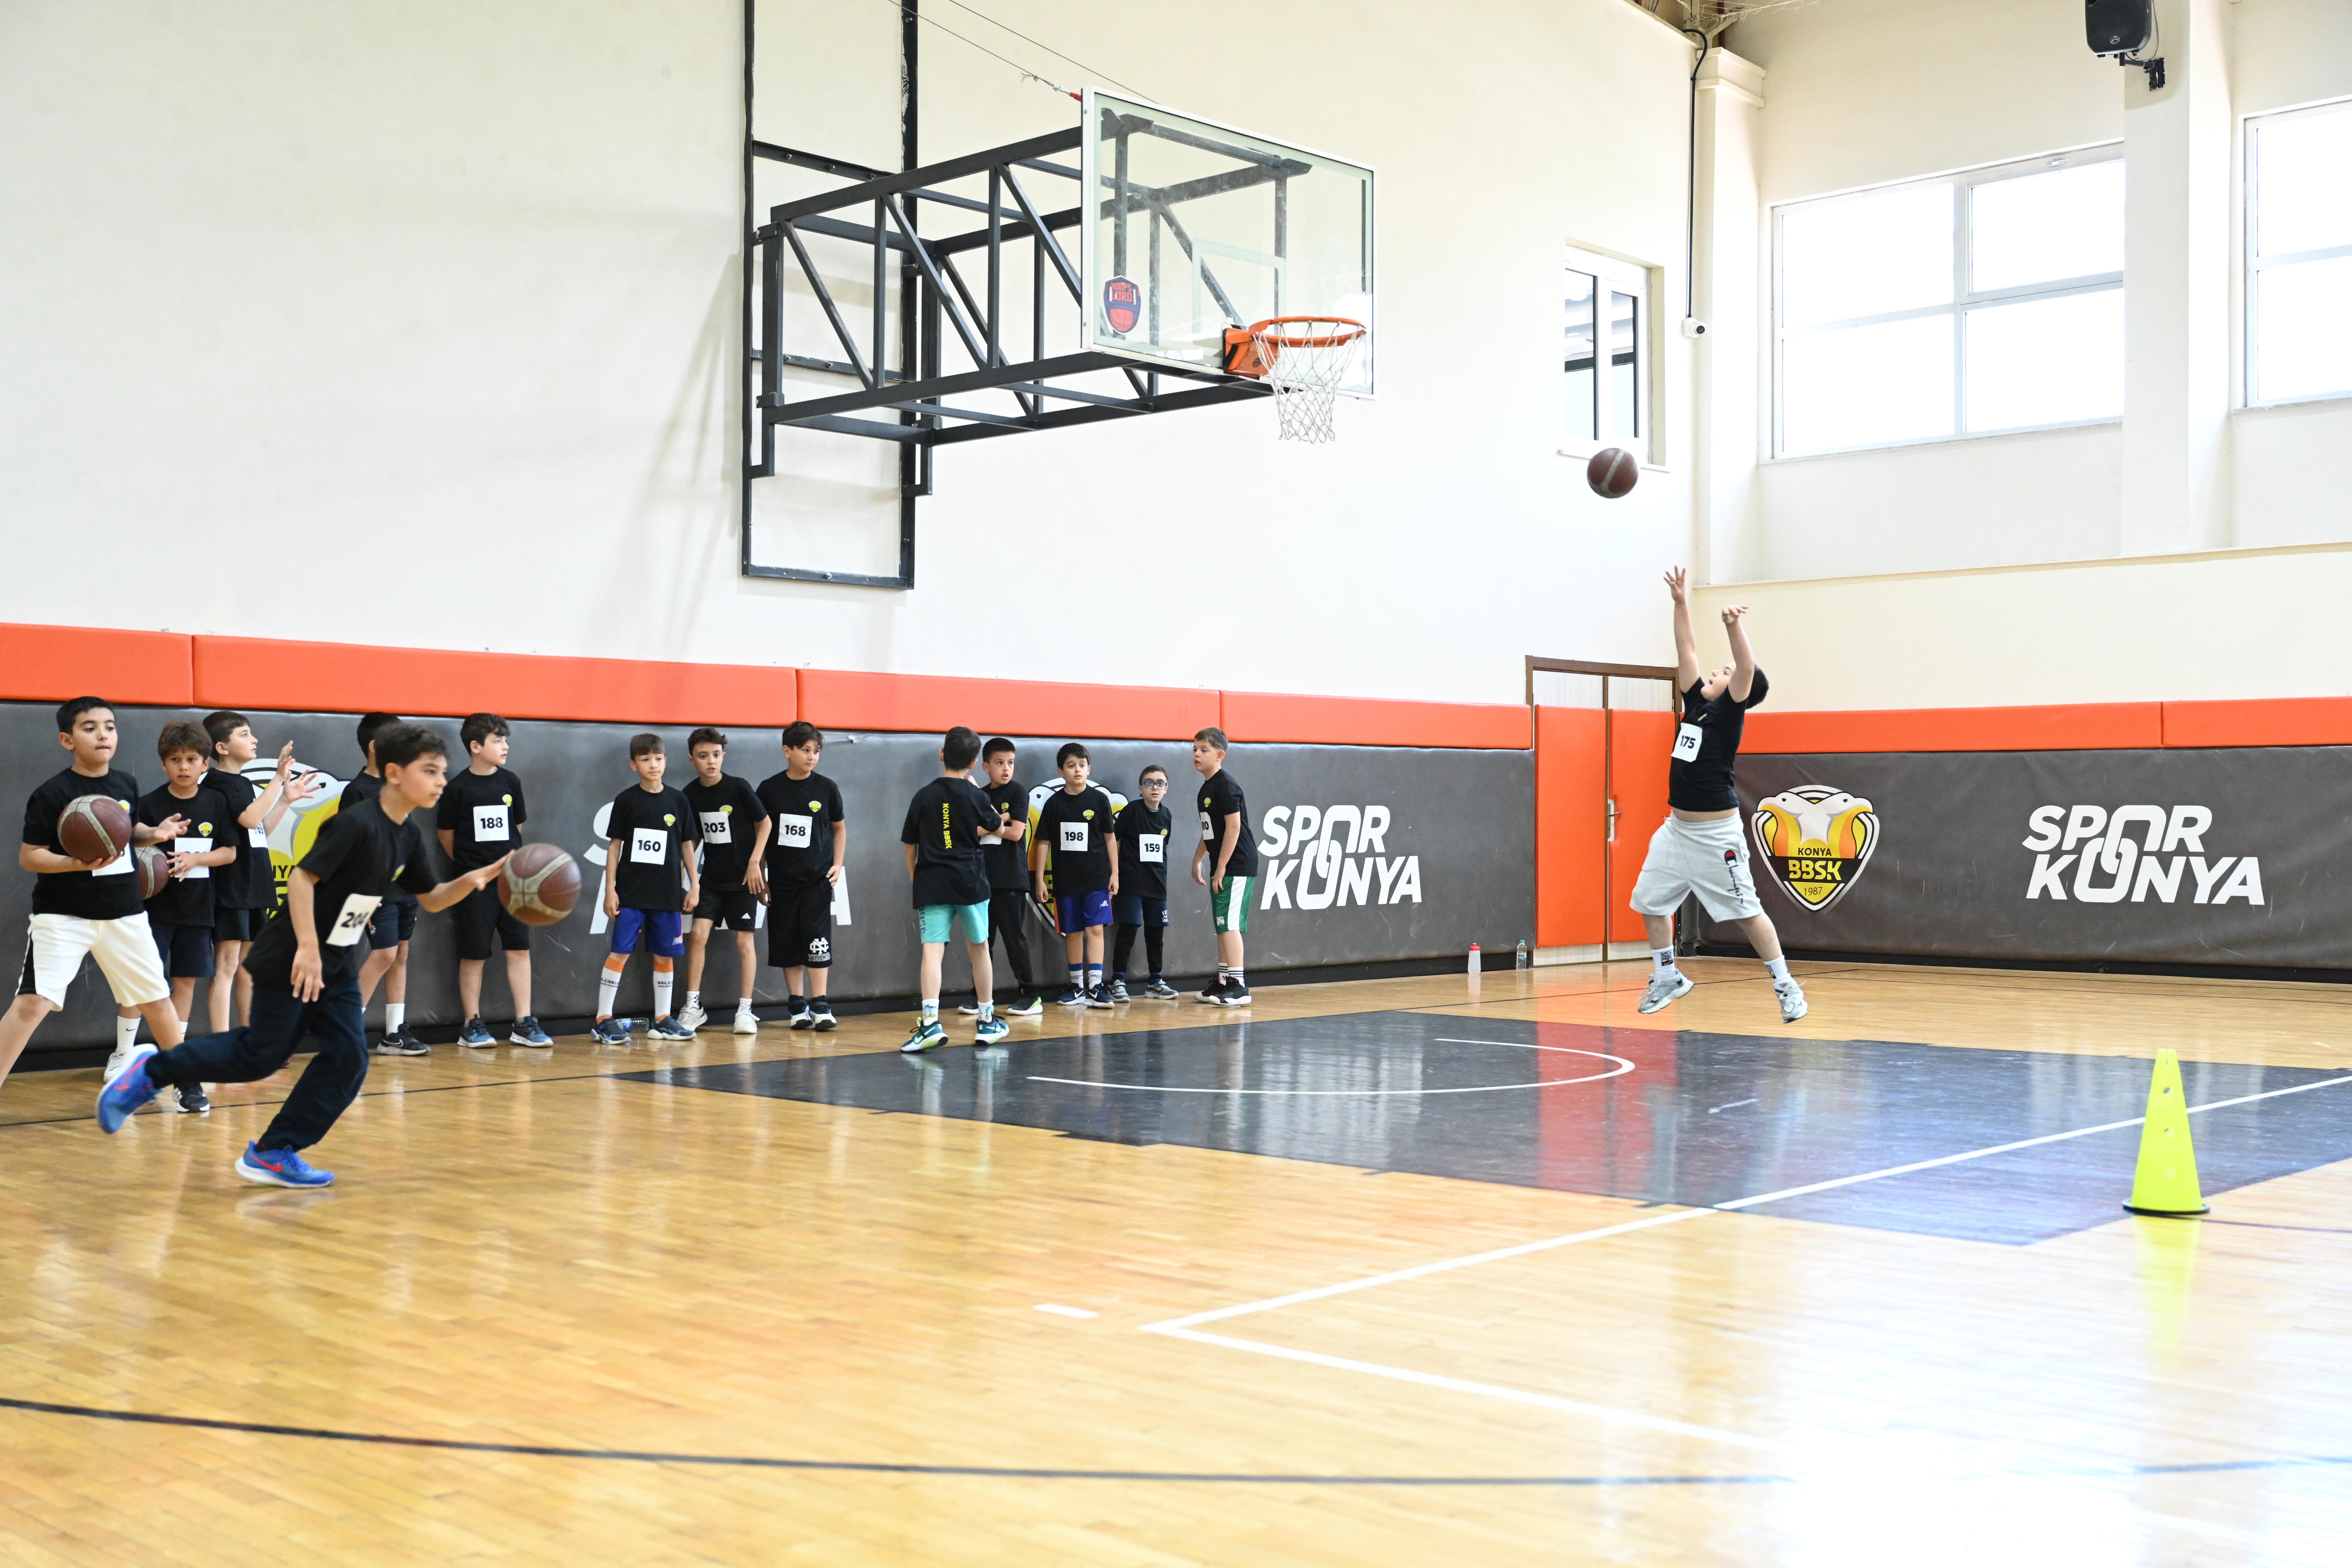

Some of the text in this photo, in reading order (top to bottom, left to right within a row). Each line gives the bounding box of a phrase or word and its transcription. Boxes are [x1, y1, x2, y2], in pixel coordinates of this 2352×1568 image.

[1111, 282, 1132, 292] HOOPS
[1111, 290, 1133, 302] LORD
[1680, 735, 1696, 749] 175
[480, 817, 503, 829] 188
[704, 822, 726, 833] 203
[785, 824, 806, 836] 168
[1065, 831, 1083, 841] 198
[638, 839, 661, 852] 160
[943, 830, 952, 849] BBSK
[1257, 805, 1390, 878] SPOR
[2022, 805, 2213, 874] SPOR
[1144, 843, 1160, 853] 159
[1798, 847, 1832, 856] KONYA
[1260, 840, 1422, 910] KONYA
[1788, 860, 1842, 880] BBSK
[2026, 838, 2265, 905] KONYA
[1724, 849, 1743, 905] Champin
[1804, 887, 1822, 896] 1987
